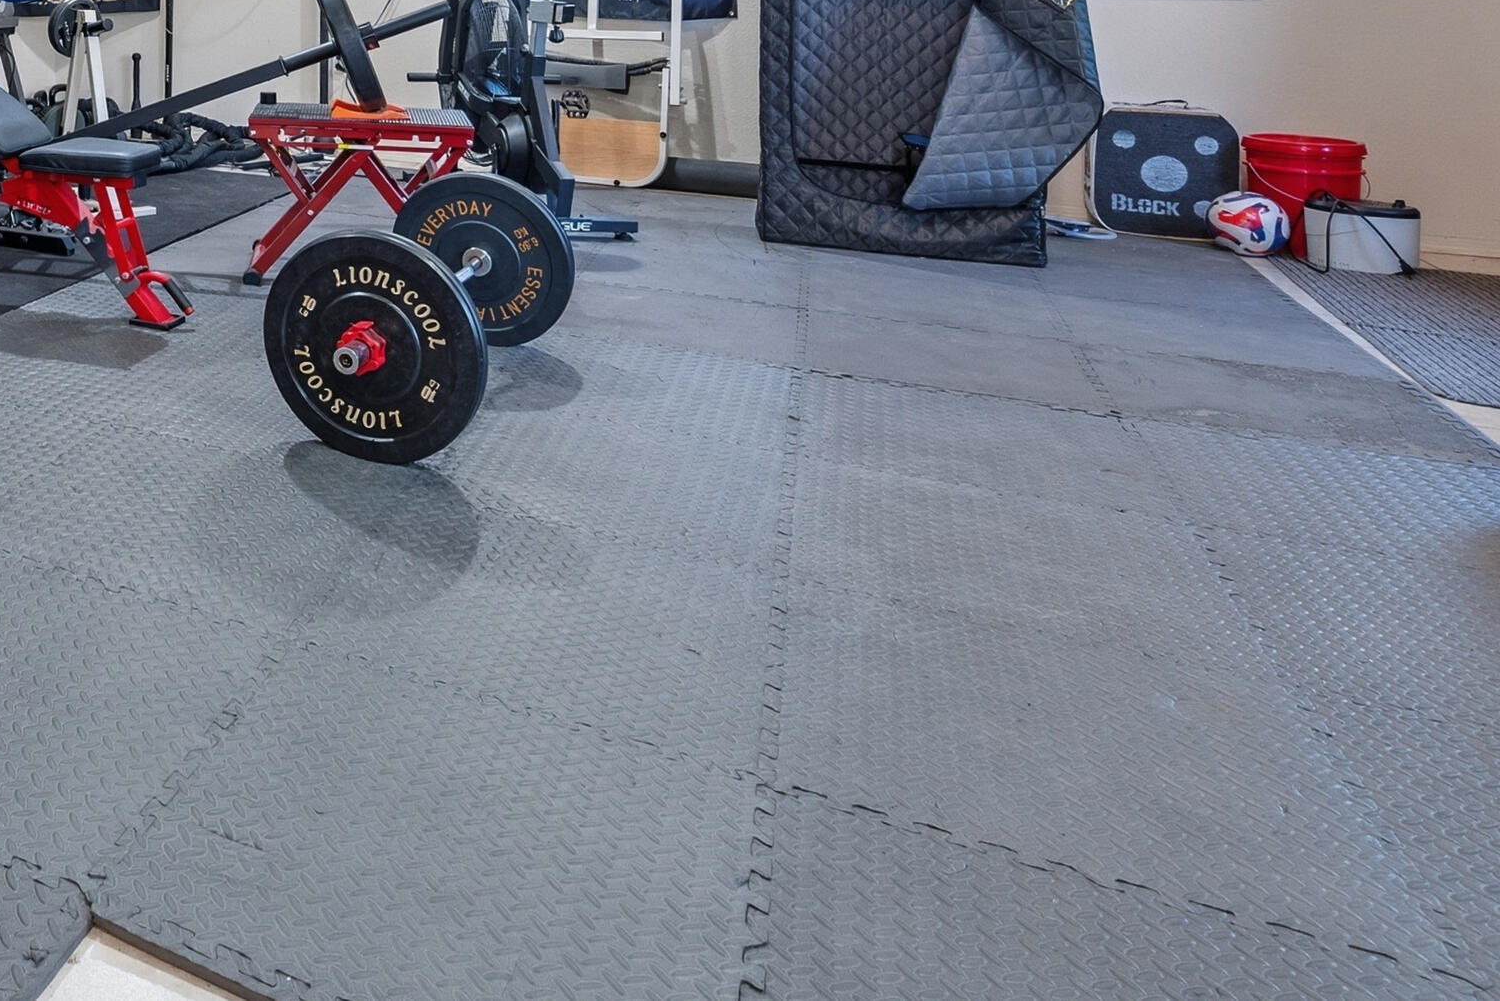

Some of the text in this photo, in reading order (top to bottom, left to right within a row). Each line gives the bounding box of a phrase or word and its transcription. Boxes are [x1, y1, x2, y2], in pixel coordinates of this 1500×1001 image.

[1111, 192, 1181, 217] BLOCK
[417, 200, 492, 247] EVERYDAY
[303, 295, 317, 311] 10
[333, 266, 446, 350] LIONSCOOL
[294, 345, 402, 430] LIONSCOOL
[420, 385, 437, 403] 10
